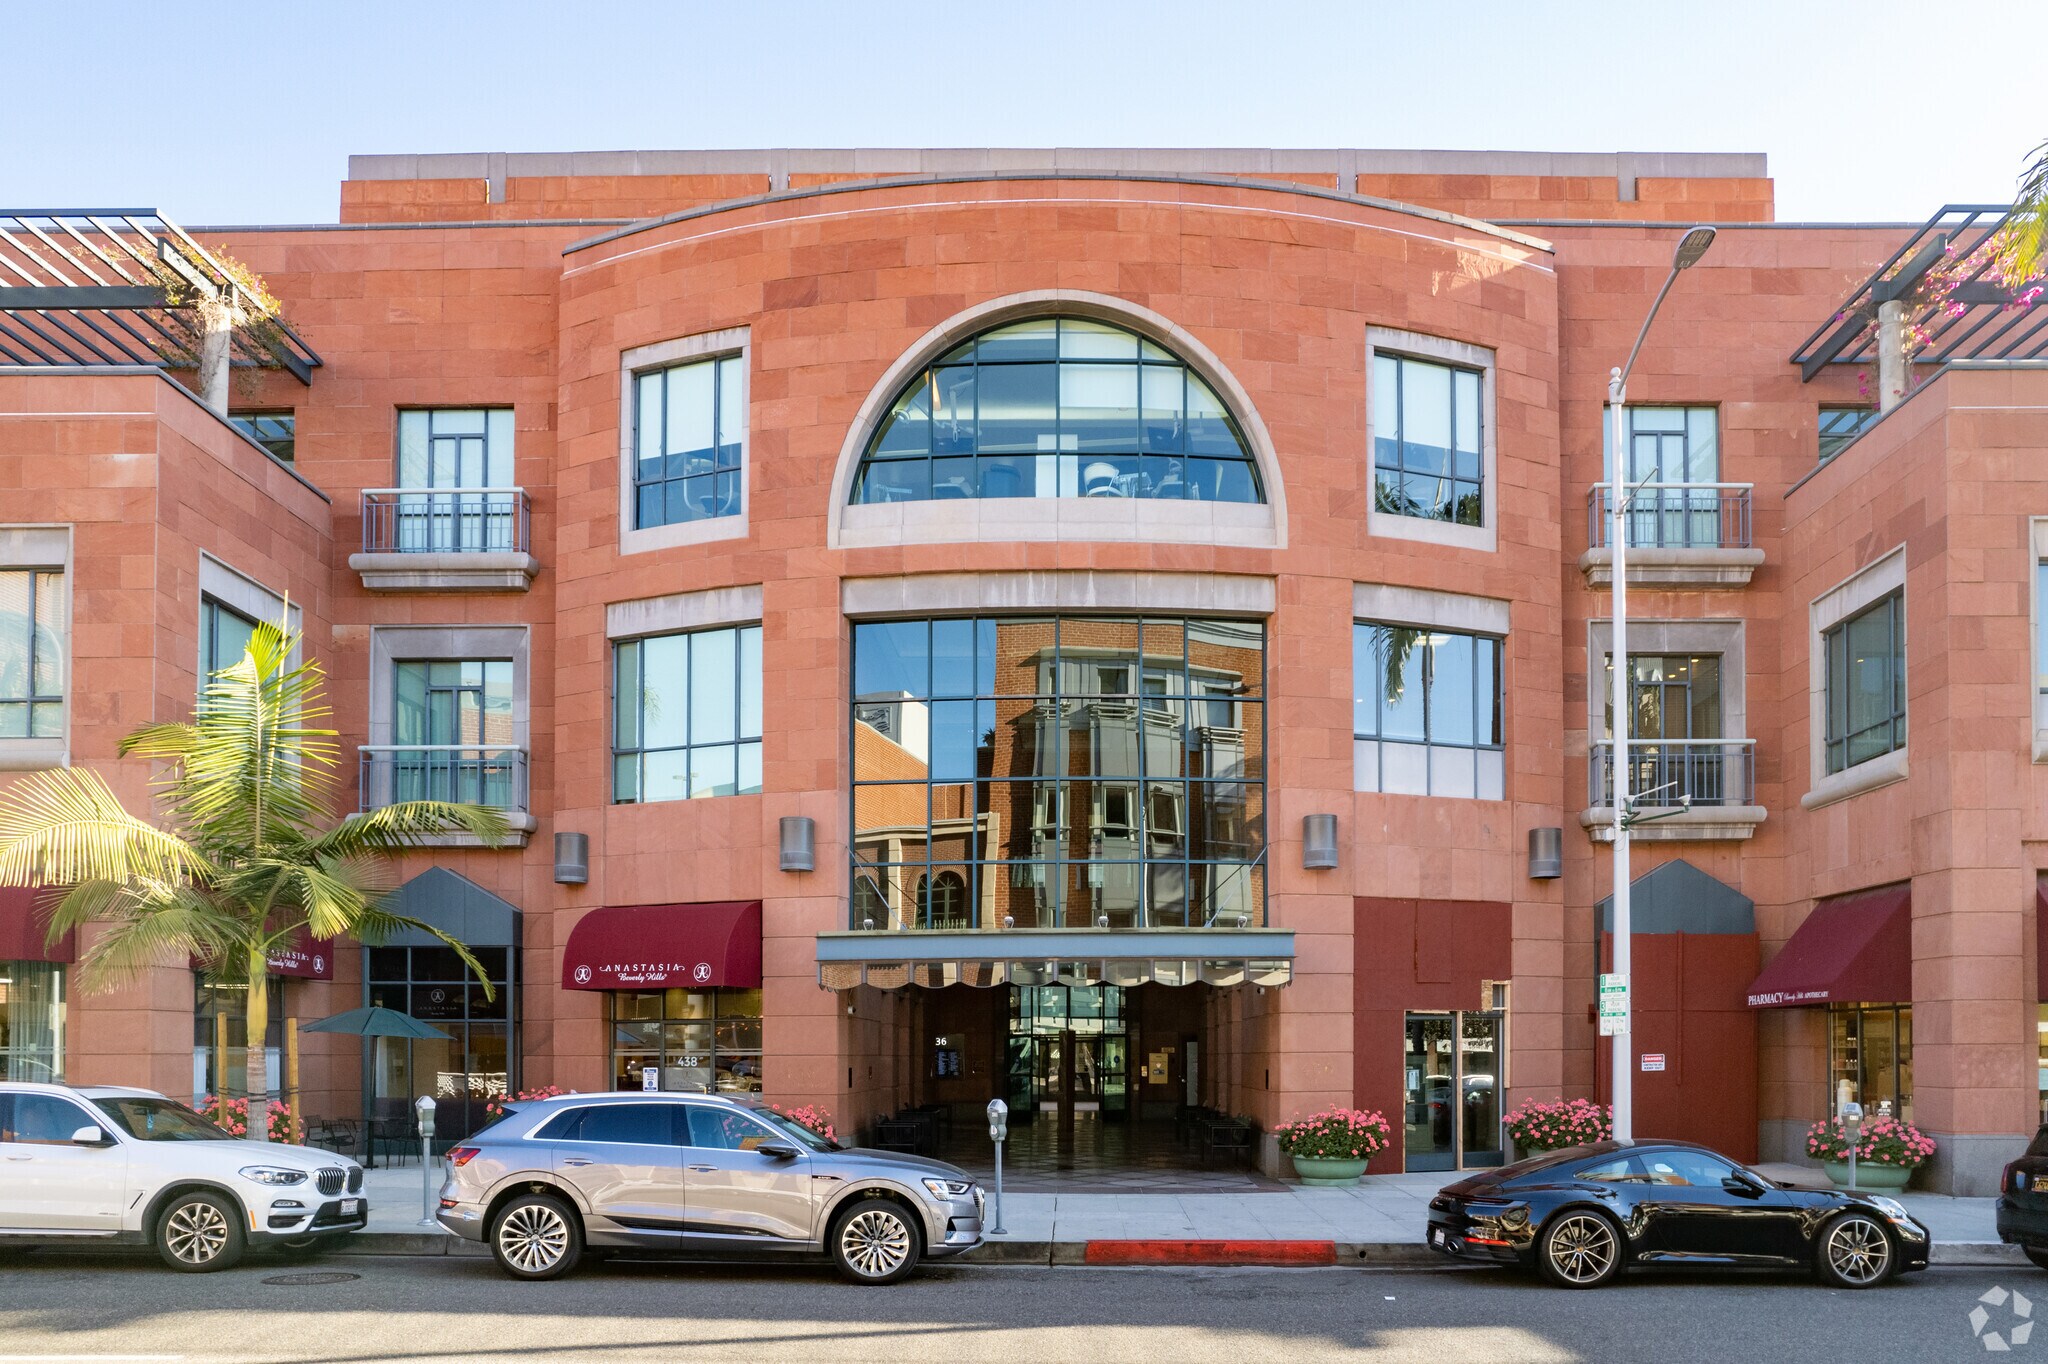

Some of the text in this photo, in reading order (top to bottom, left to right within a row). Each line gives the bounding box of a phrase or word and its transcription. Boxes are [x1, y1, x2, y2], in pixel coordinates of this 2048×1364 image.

[600, 963, 685, 972] ANASTASIA
[618, 973, 645, 983] Beverly
[1748, 992, 1784, 1006] PHARMACY
[935, 1037, 947, 1046] 36
[677, 1056, 698, 1067] 438
